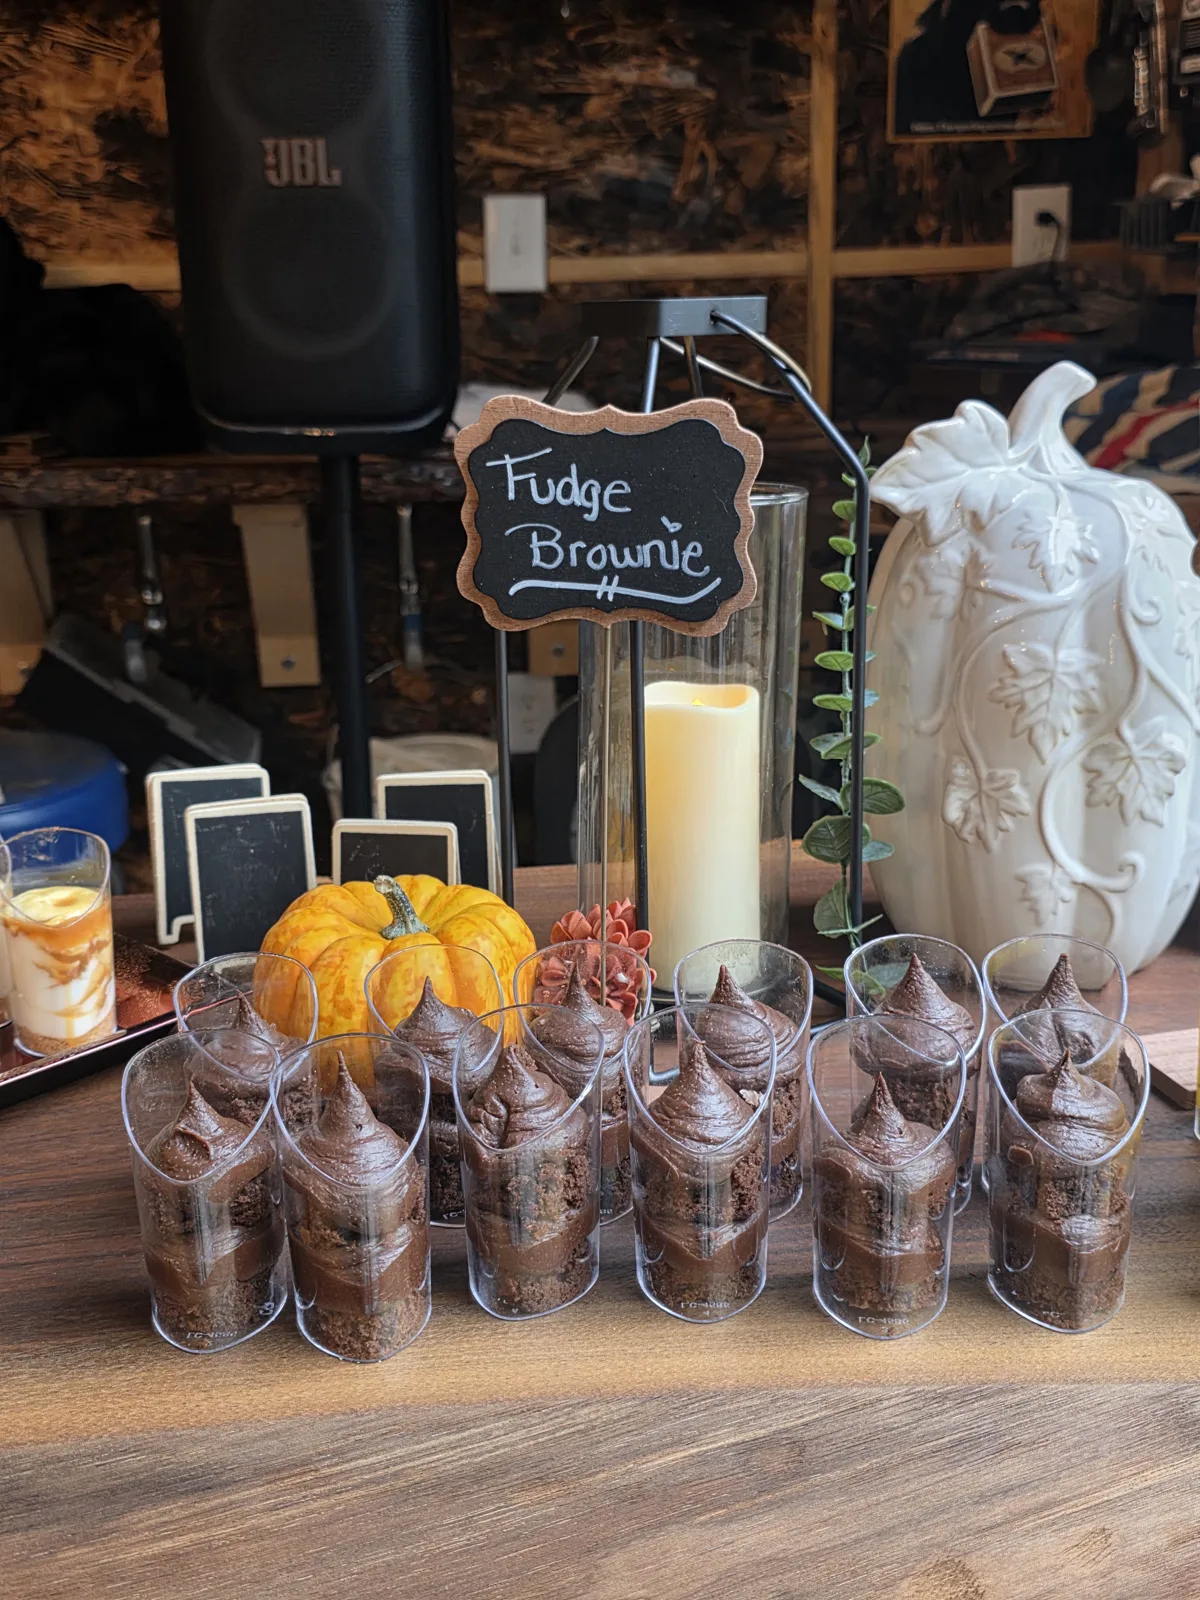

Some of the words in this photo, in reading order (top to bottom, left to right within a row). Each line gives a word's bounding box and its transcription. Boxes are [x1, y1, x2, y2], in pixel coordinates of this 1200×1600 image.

[261, 137, 342, 187] JBL
[486, 448, 632, 522] Fudge
[505, 516, 710, 577] Brownie
